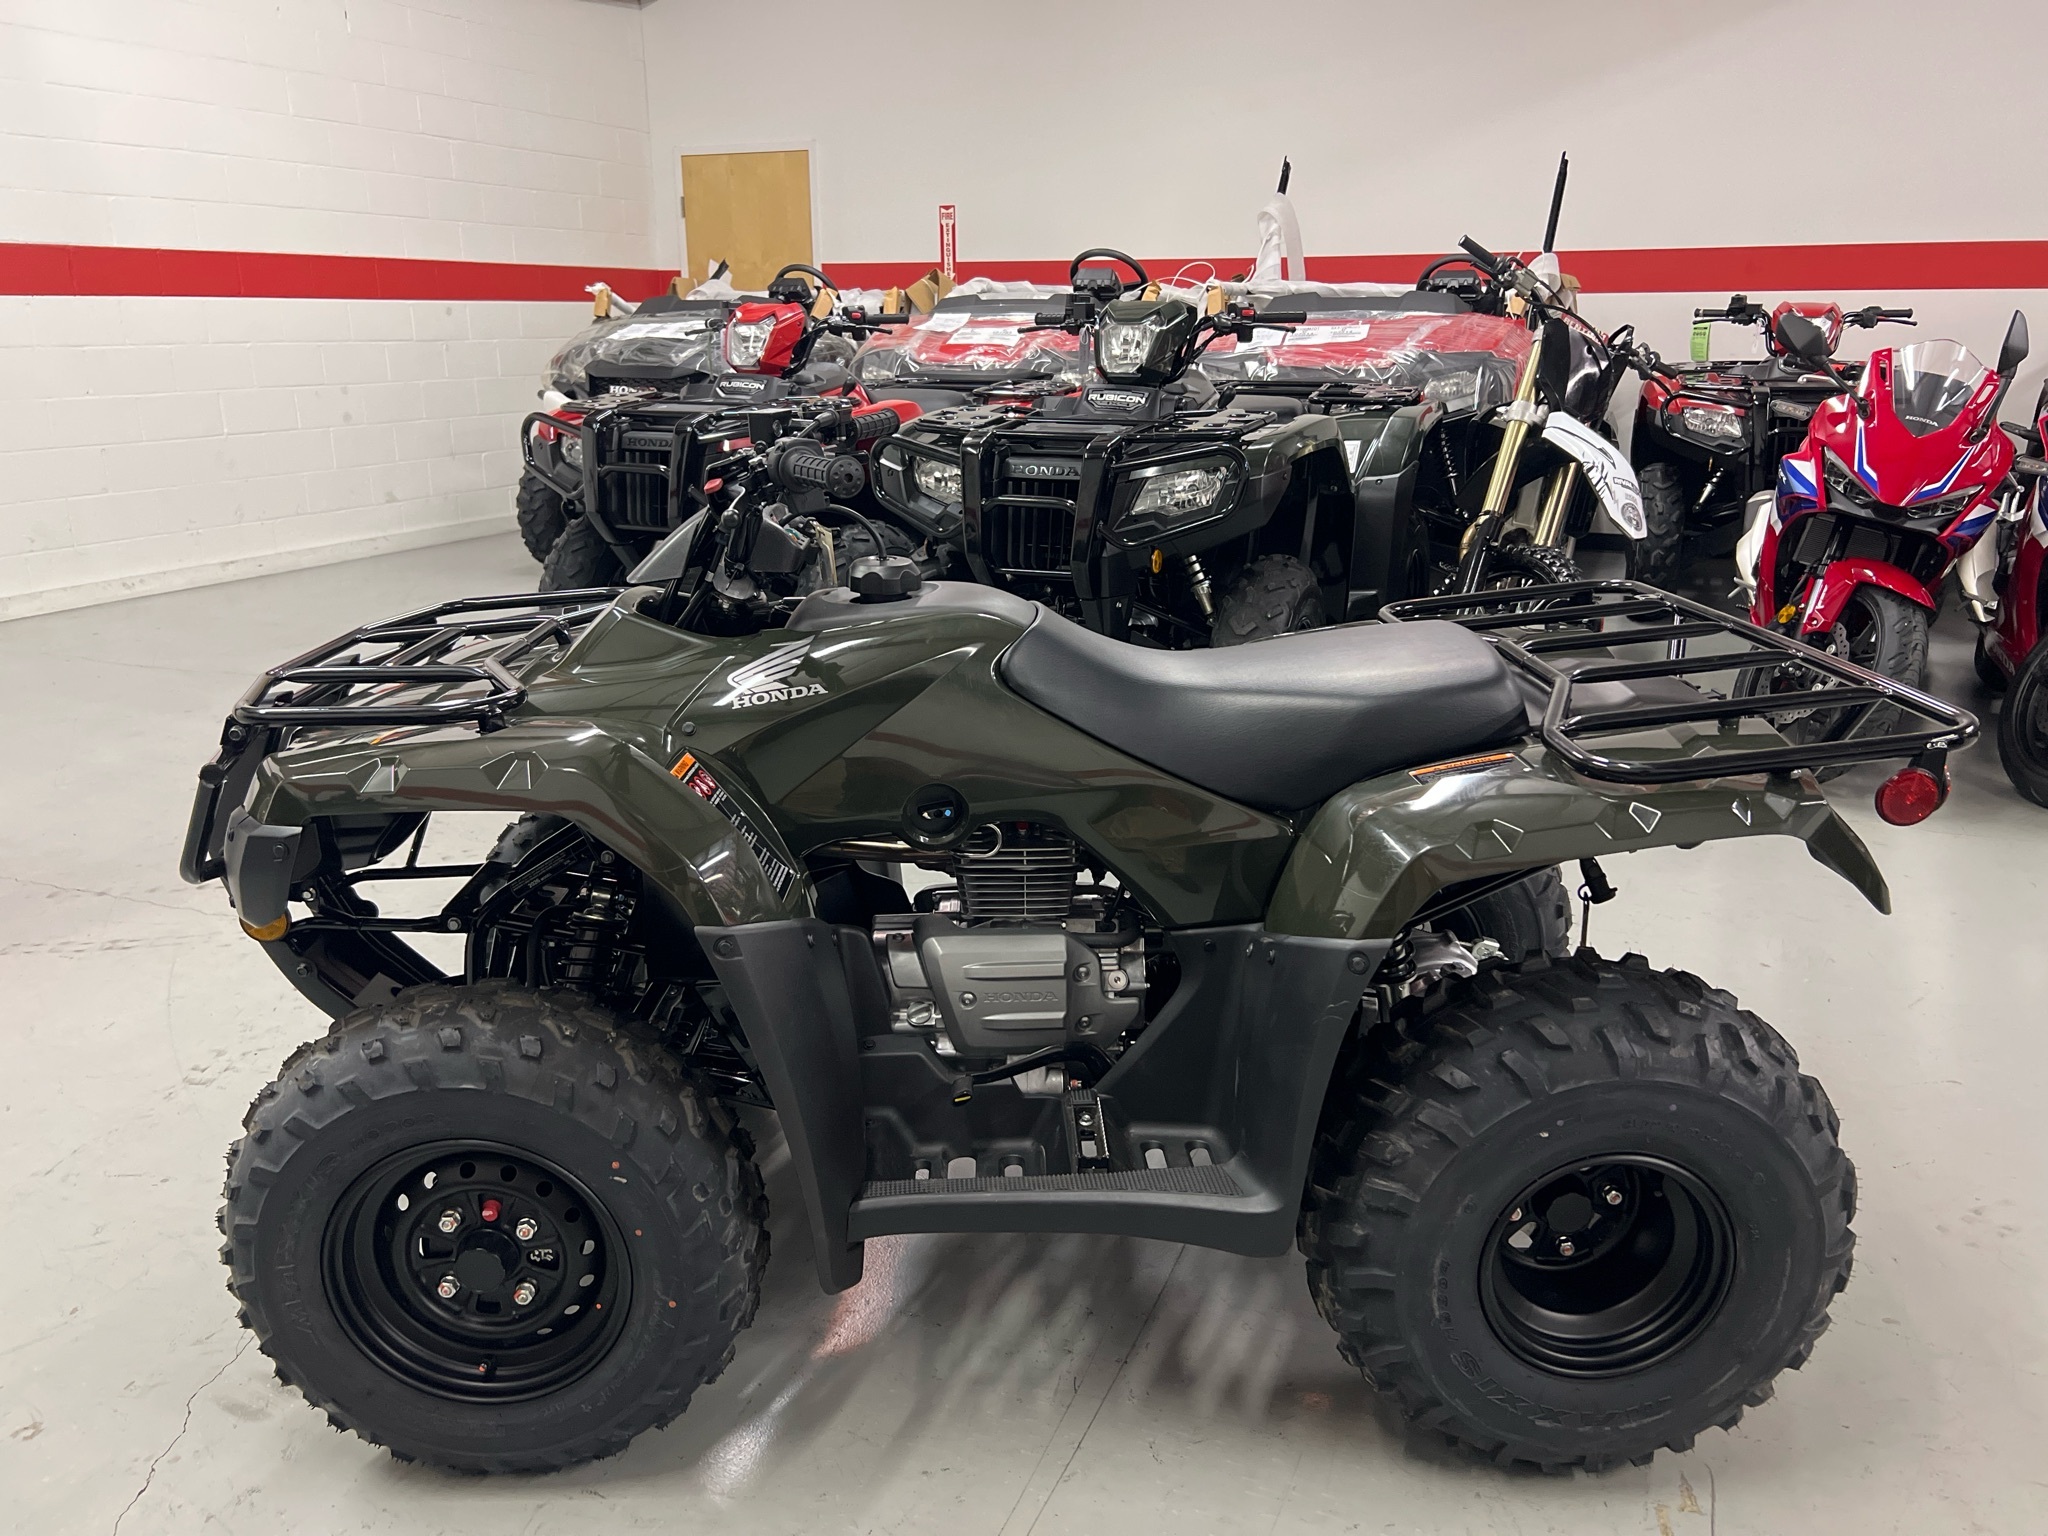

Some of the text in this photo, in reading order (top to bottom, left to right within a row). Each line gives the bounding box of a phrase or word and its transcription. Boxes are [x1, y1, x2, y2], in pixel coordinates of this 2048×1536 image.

[942, 212, 953, 220] FIRE
[719, 381, 765, 391] RUBICON
[1087, 393, 1146, 405] RUBICON
[1905, 415, 1939, 427] HONDA
[1012, 465, 1081, 477] HONDA
[731, 683, 829, 710] HONDA
[984, 991, 1059, 1003] HONDA
